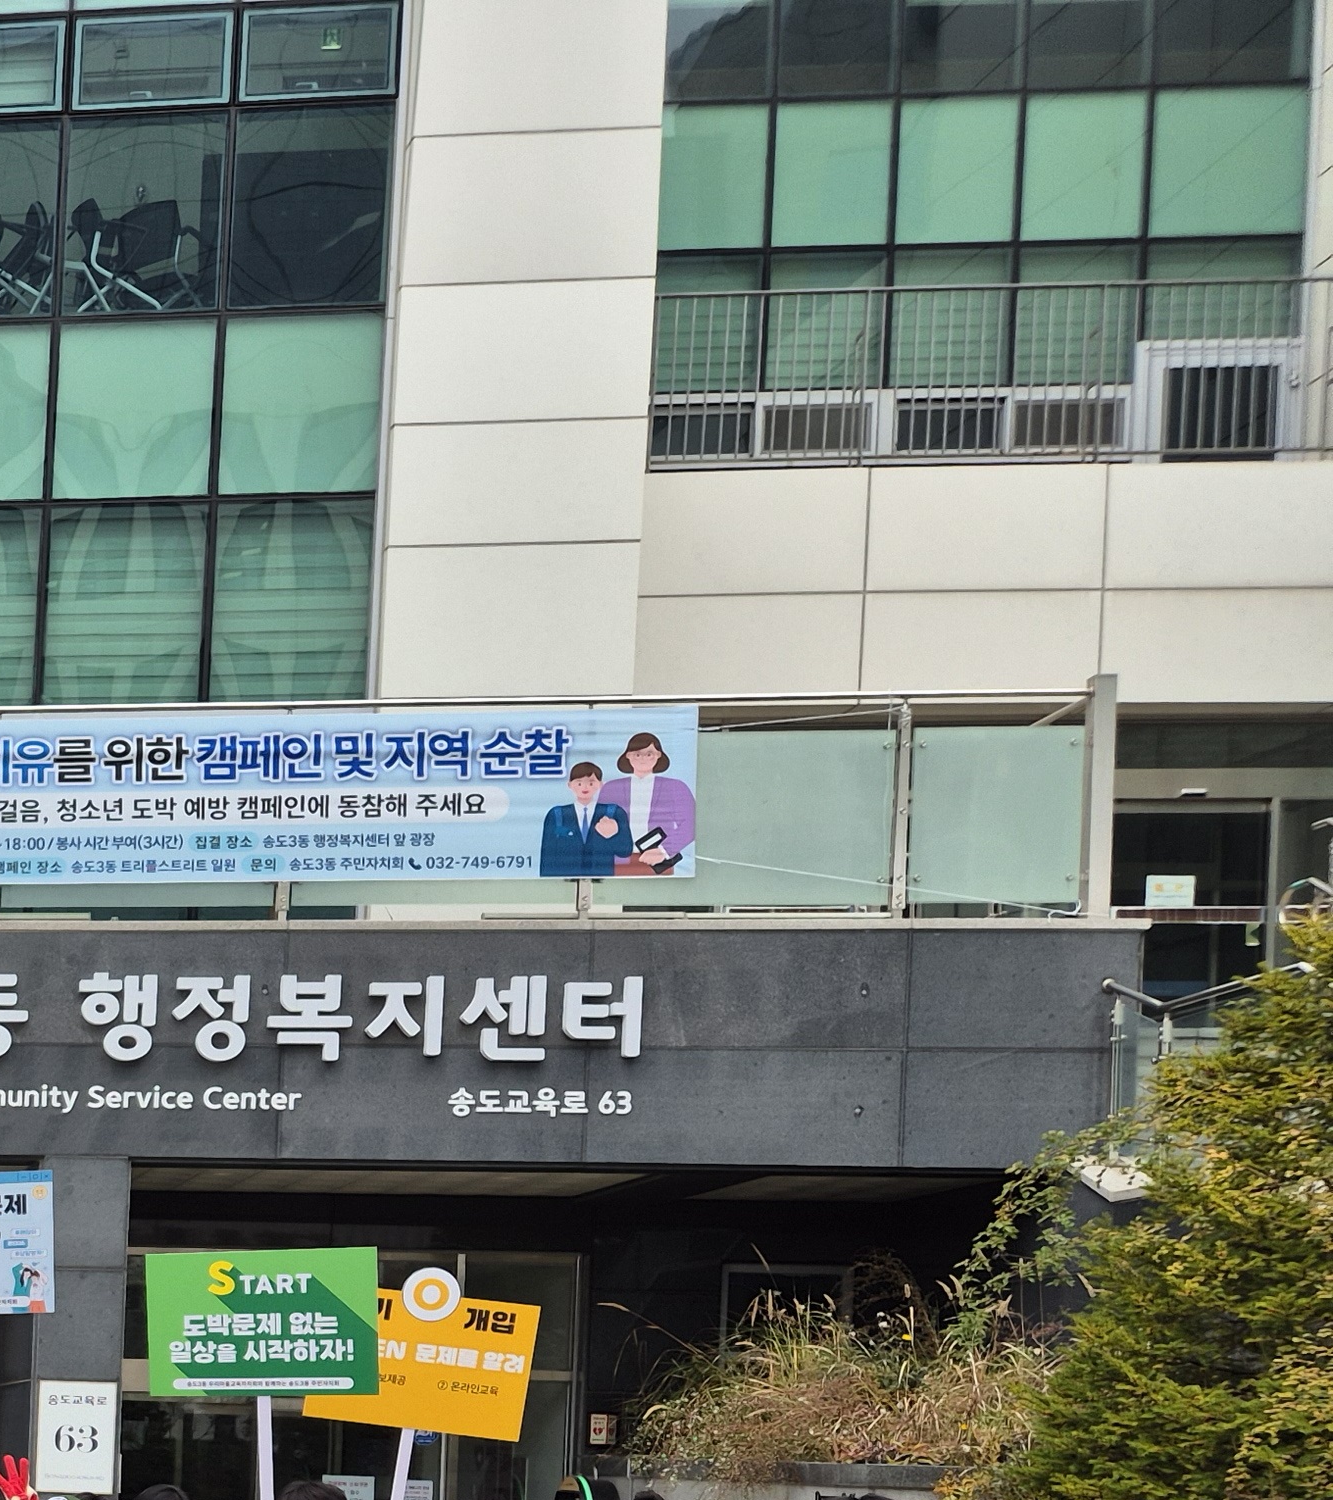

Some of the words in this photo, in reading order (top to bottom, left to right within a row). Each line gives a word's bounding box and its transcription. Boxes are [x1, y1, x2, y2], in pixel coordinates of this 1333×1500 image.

[101, 736, 189, 783] 위한
[195, 734, 322, 781] 캠페인
[334, 732, 375, 779] 및
[384, 730, 469, 778] 지역
[478, 729, 571, 778] 순찰
[56, 798, 124, 823] 청소년
[131, 796, 178, 821] 도박
[184, 795, 230, 821] 예방
[237, 794, 330, 820] 캠페인에
[337, 793, 407, 819] 동참해
[415, 792, 486, 817] 주세요
[83, 835, 110, 851] 시간
[111, 834, 184, 851] 부여(3시간)
[195, 835, 221, 850] 집결
[226, 835, 253, 850] 장소
[262, 834, 310, 849] 송도3동
[313, 832, 390, 849] 행정복지센터
[393, 832, 406, 847] 앞
[409, 832, 436, 847] 광장
[36, 860, 62, 875] 장소
[71, 860, 117, 874] 송도3동
[120, 858, 208, 873] 트리플스트리트
[210, 858, 236, 873] 일원
[250, 857, 277, 872] 문의
[289, 857, 337, 872] 송도3동
[340, 856, 404, 871] 주민자치회
[425, 855, 532, 870] 032-749-6791
[77, 971, 645, 1063] 행정복지센터
[87, 1085, 194, 1112] Service
[202, 1086, 303, 1112] Center
[447, 1087, 589, 1118] 송도교육로
[597, 1090, 634, 1116] 63
[207, 1260, 312, 1295] START
[183, 1313, 282, 1337] 도박문제
[289, 1312, 338, 1335] 없는
[464, 1307, 516, 1335] 개입
[169, 1340, 237, 1364] 일상을
[244, 1339, 354, 1363] 시작하자!
[415, 1342, 479, 1369] 문제를
[482, 1351, 526, 1374] 알려
[48, 1395, 107, 1406] 송도교육로
[451, 1381, 499, 1396] 온라인교육
[54, 1425, 99, 1453] 63
